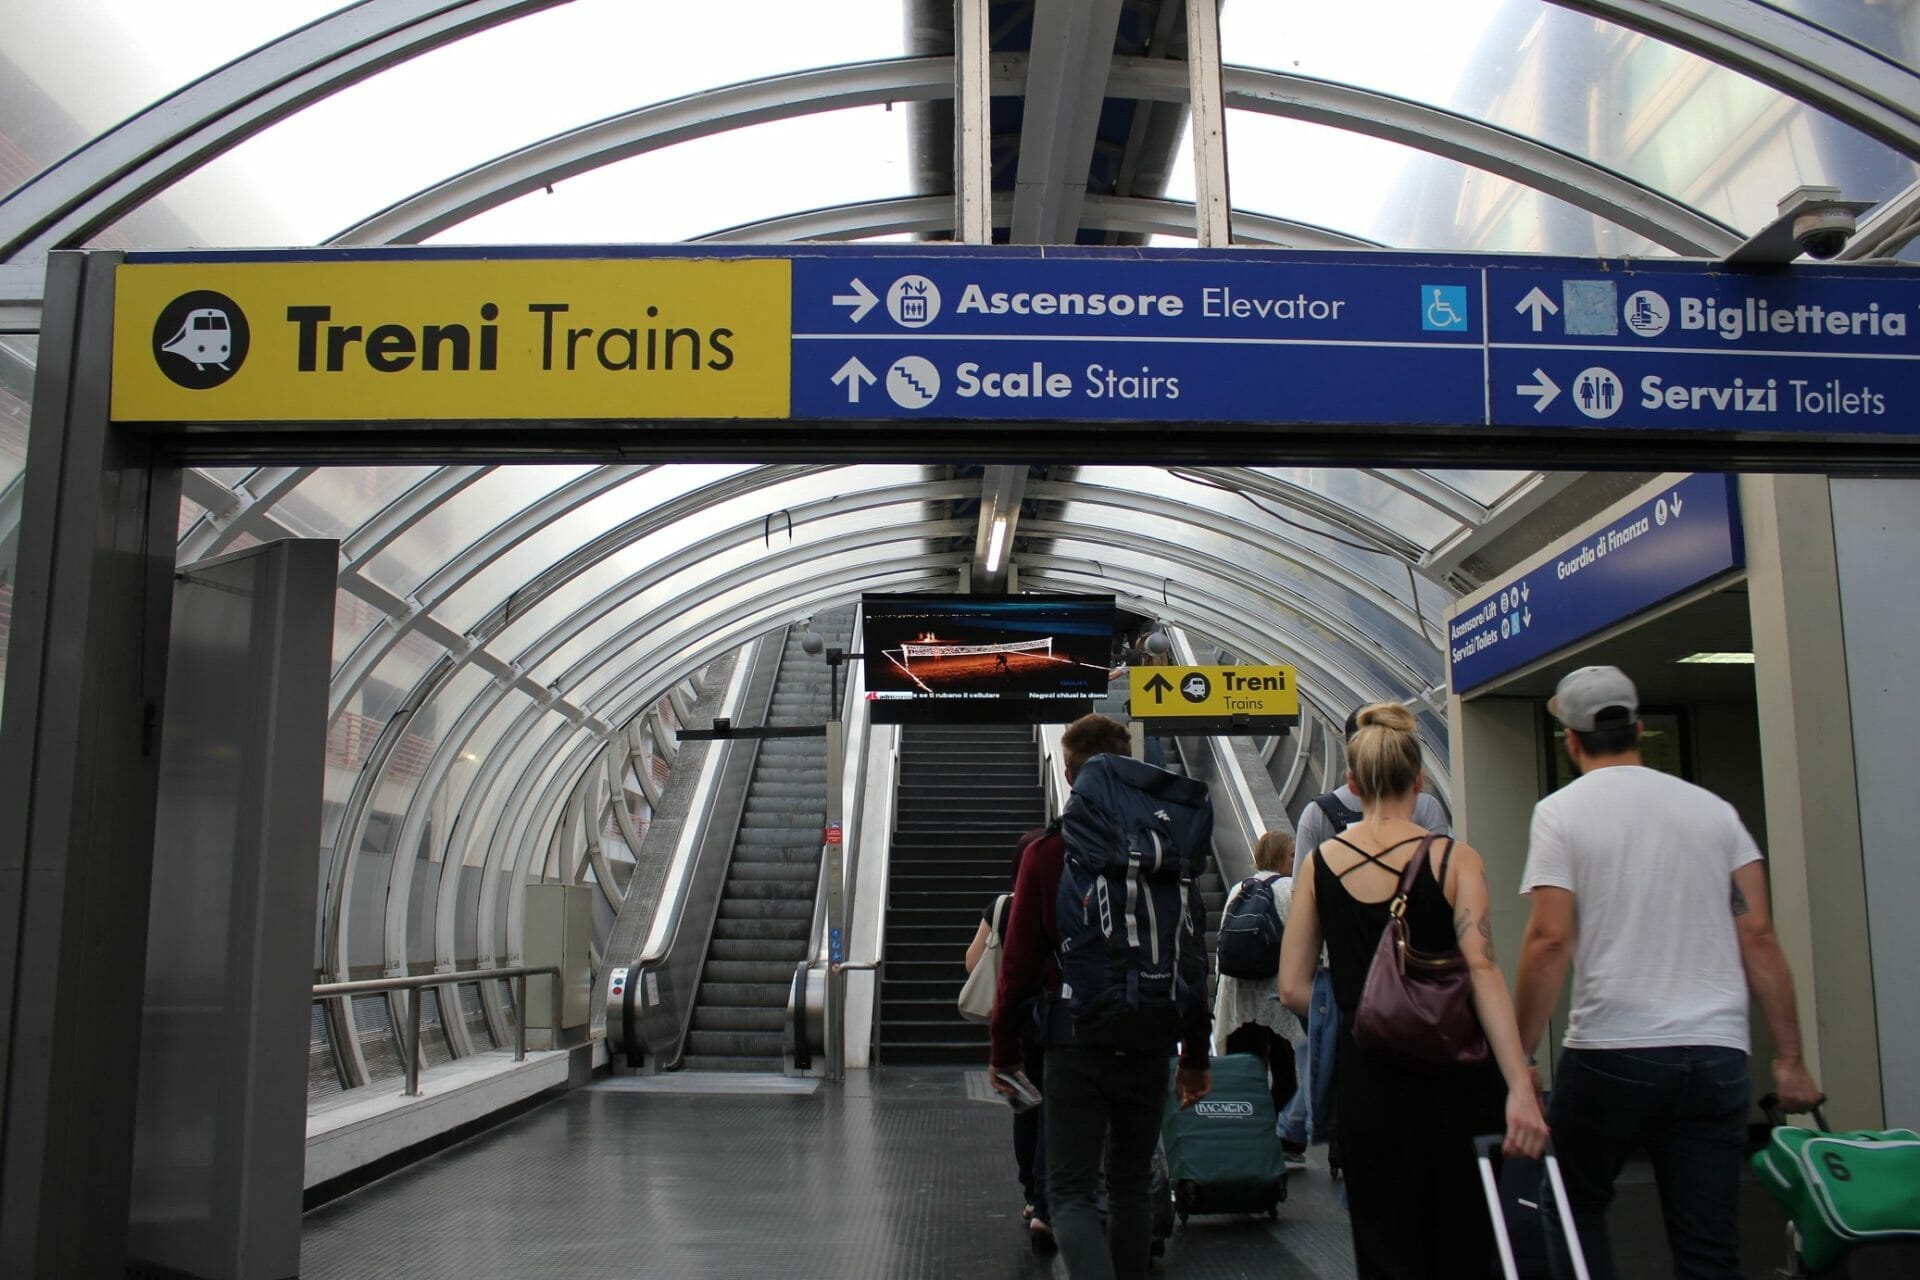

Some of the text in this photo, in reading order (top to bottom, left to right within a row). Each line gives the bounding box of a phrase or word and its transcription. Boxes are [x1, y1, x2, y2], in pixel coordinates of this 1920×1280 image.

[956, 283, 1345, 320] Ascensore Elevator
[1680, 297, 1906, 340] Biglietteria
[286, 302, 735, 373] Treni Trains
[956, 362, 1180, 400] Scale Stairs
[1641, 375, 1886, 416] Servizi Toilets
[1557, 517, 1649, 580] Guardia di Finanza
[1451, 600, 1497, 641] Ascensore/Lift
[1452, 629, 1498, 664] Servizi/Toilets
[1029, 692, 1055, 700] Negozi
[1222, 671, 1286, 710] Treni Trains
[1823, 1152, 1851, 1181] 6
